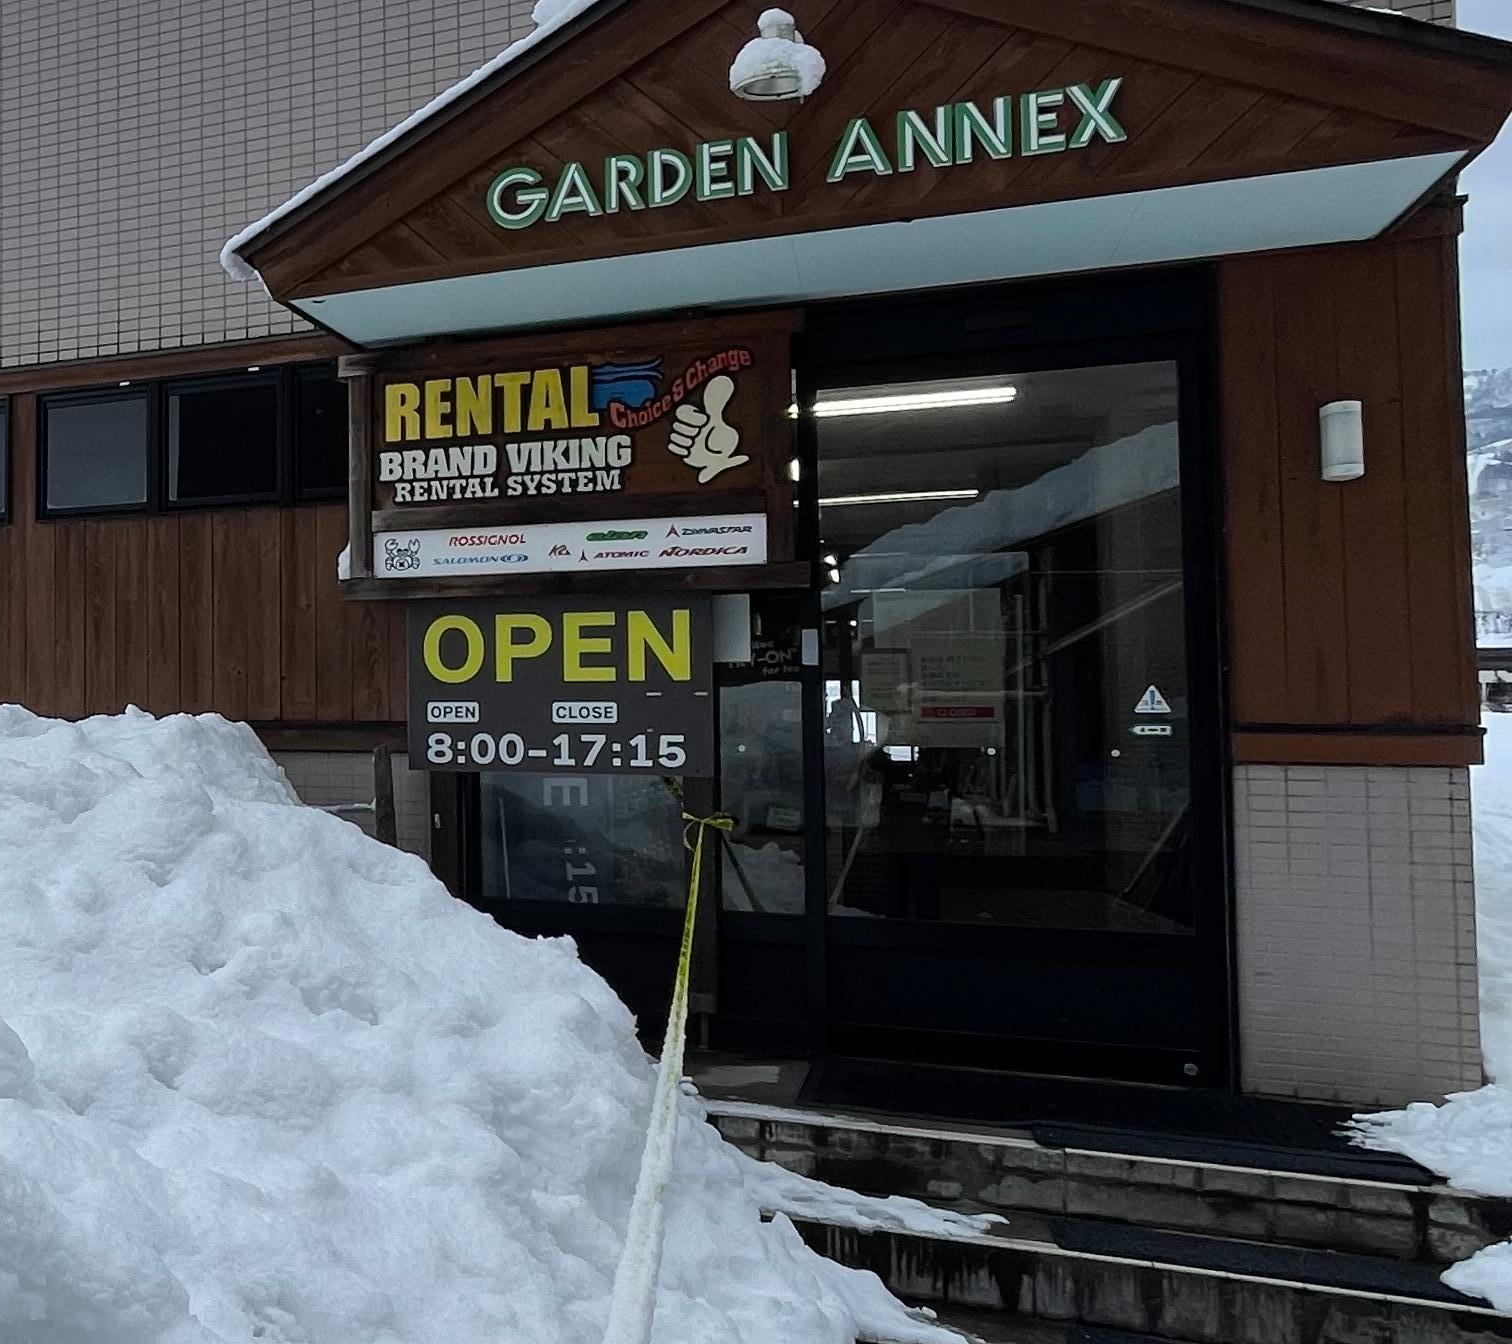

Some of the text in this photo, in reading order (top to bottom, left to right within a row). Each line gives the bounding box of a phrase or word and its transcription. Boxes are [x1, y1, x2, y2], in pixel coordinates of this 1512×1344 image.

[486, 77, 1128, 231] GARDEN ANNEX
[385, 366, 599, 443] RENTAL
[609, 394, 672, 428] Choice
[685, 349, 752, 390] Change
[379, 434, 632, 483] BRAND VIKING
[393, 469, 622, 504] RENTAL SYSTEM
[448, 533, 527, 547] ROSSIGNOL
[593, 550, 650, 559] ATOMIC
[658, 546, 748, 557] NORDICA
[431, 555, 499, 566] SALOMON
[423, 609, 691, 684] OPEN
[430, 703, 614, 721] OPEN CLOSE
[426, 732, 686, 768] 8:00-17:15
